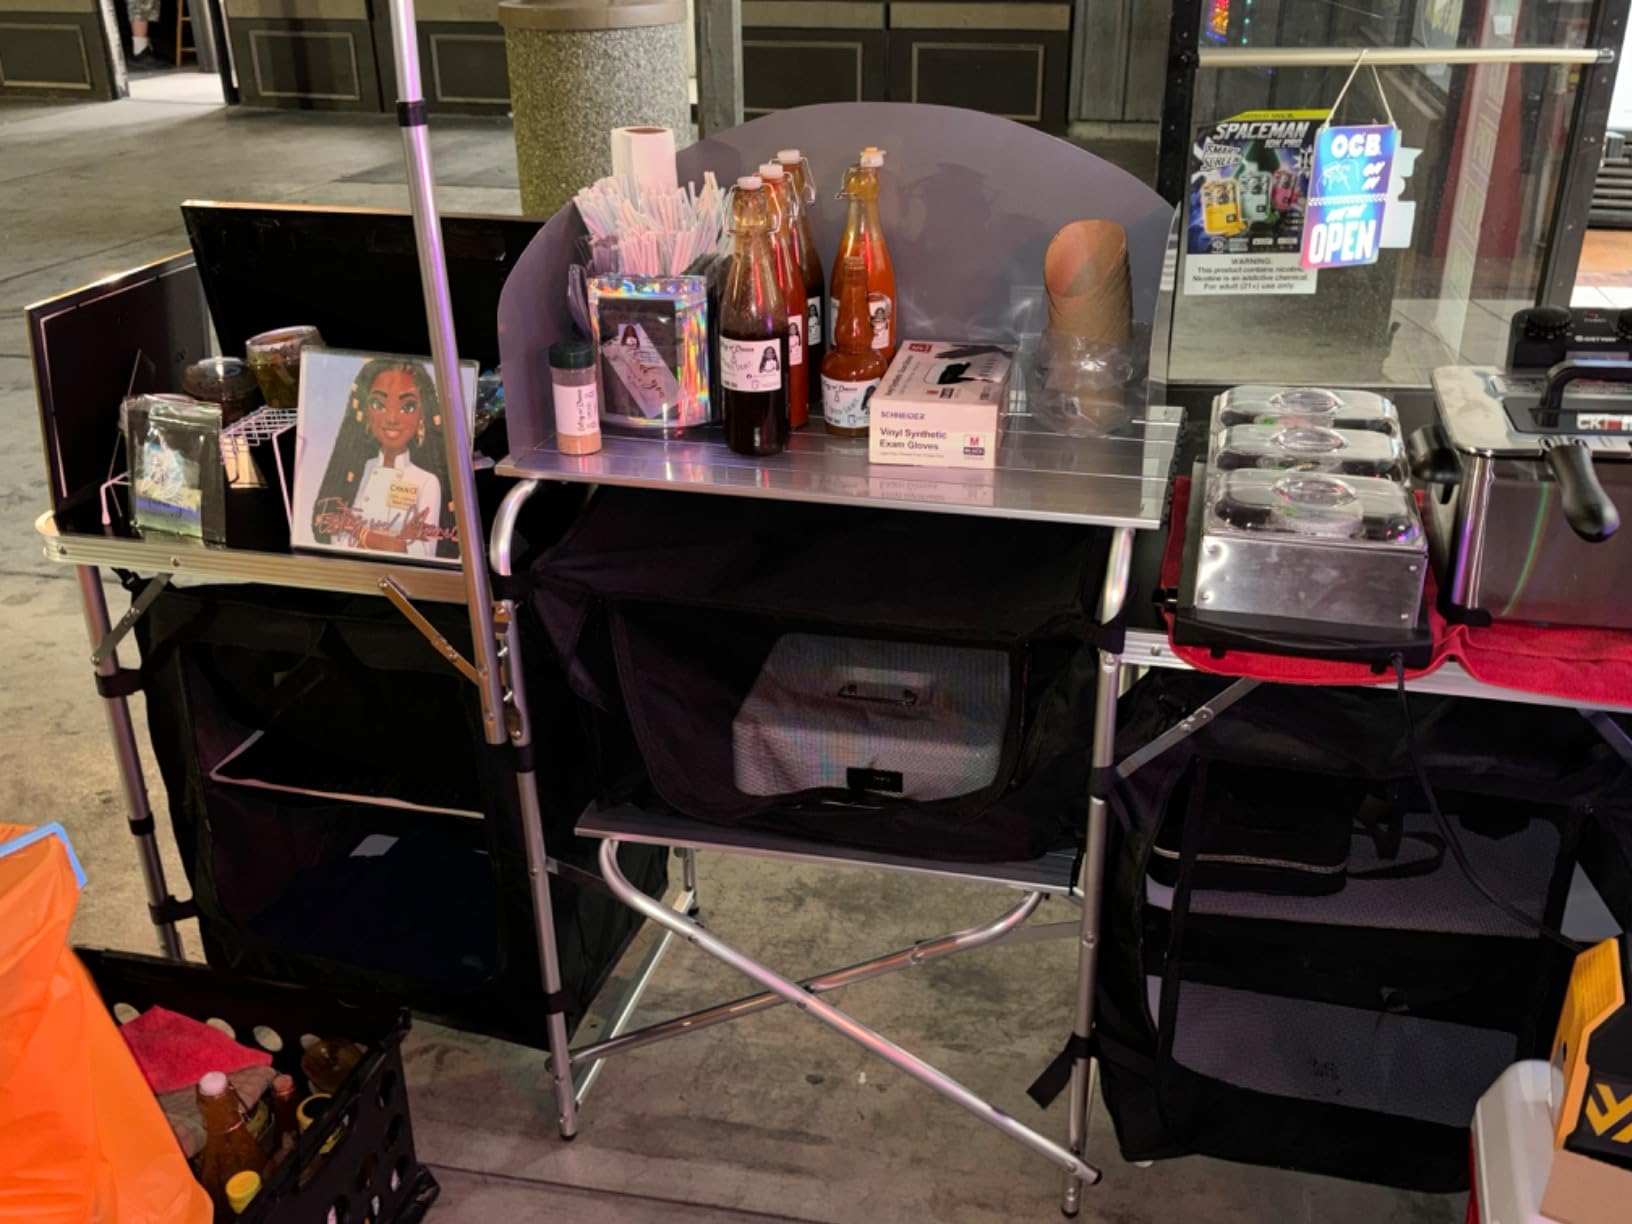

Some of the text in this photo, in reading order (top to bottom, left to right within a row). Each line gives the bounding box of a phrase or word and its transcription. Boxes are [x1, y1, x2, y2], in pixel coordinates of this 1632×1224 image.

[1213, 121, 1310, 140] SPACEMAN
[1204, 143, 1241, 154] SMART
[1282, 138, 1303, 148] PRO
[1331, 133, 1382, 159] OCB
[1308, 219, 1377, 264] OPEN
[1214, 266, 1242, 275] product
[880, 428, 947, 439] Vinyl Synthetic
[880, 439, 939, 450] Exam Gloves
[969, 437, 980, 446] M
